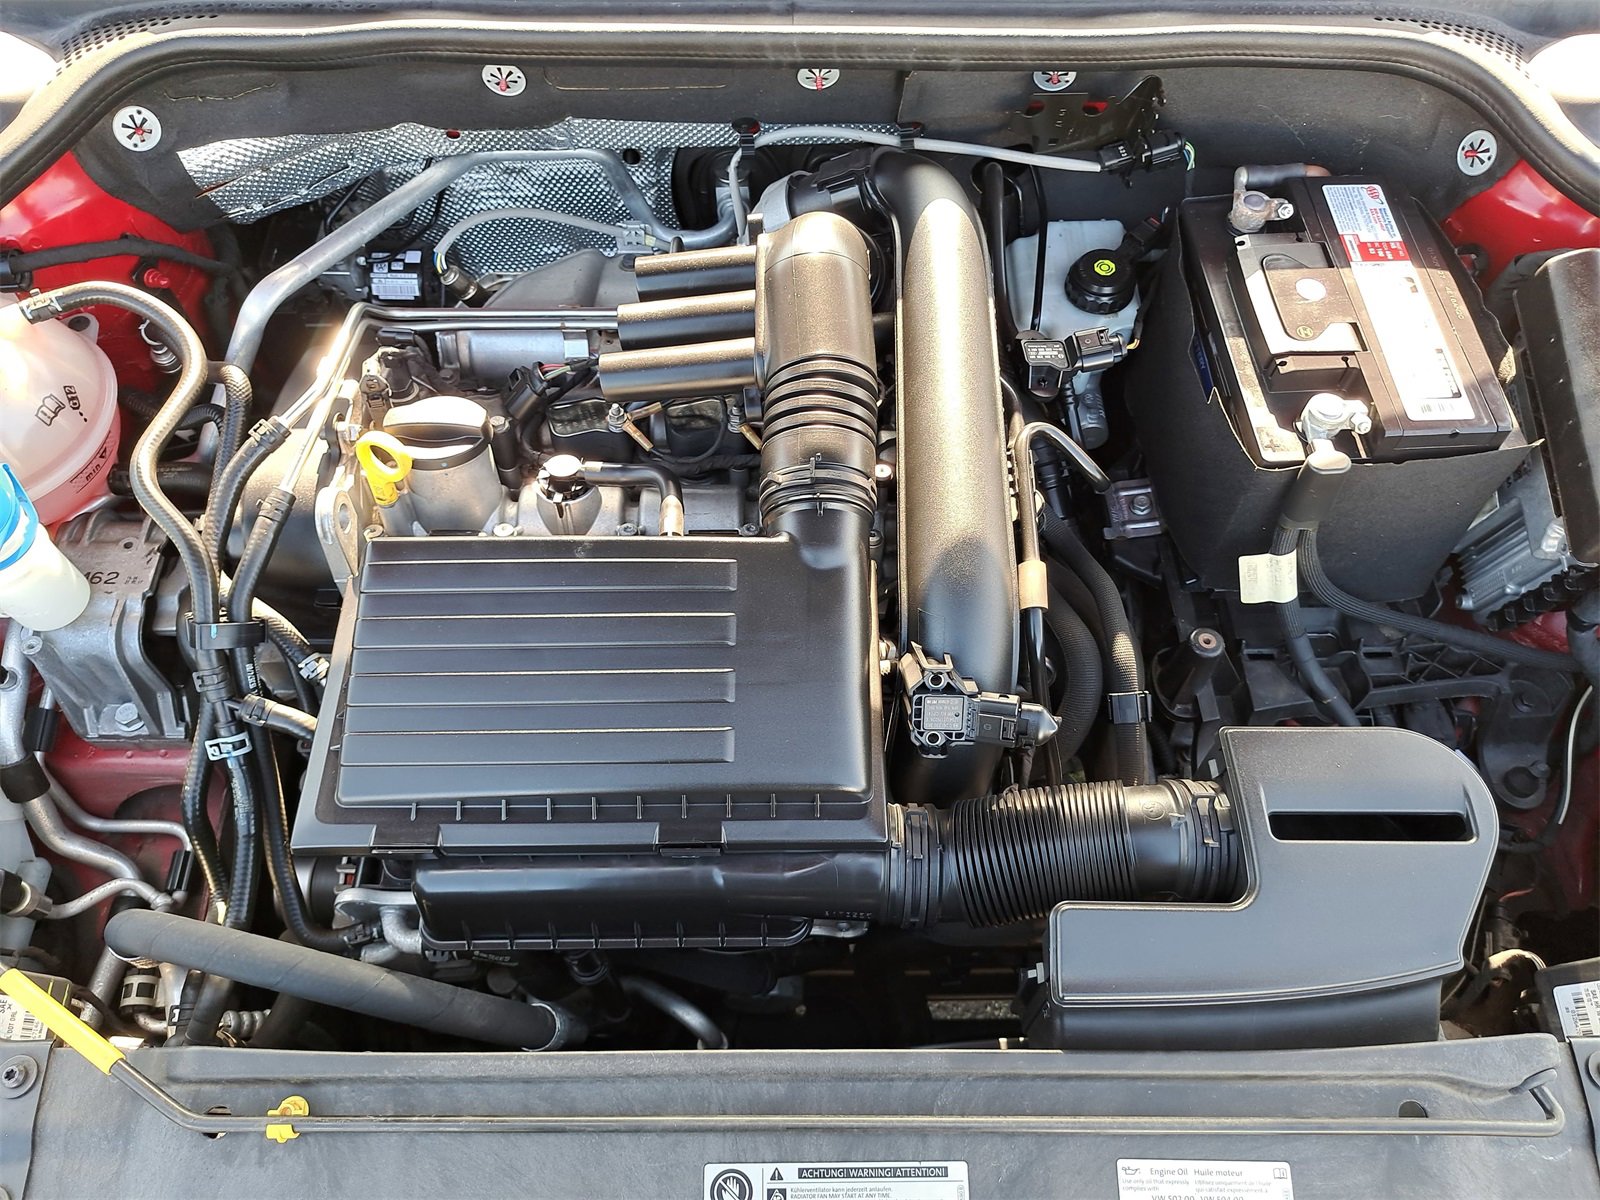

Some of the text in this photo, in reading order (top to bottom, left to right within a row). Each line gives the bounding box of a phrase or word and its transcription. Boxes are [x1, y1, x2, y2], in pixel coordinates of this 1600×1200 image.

[85, 463, 101, 482] min
[801, 1167, 945, 1178] ACHTUNG! WARNING! ATTENTION!
[1150, 1168, 1188, 1178] Engine Oil
[1193, 1168, 1243, 1177] Huile moteur
